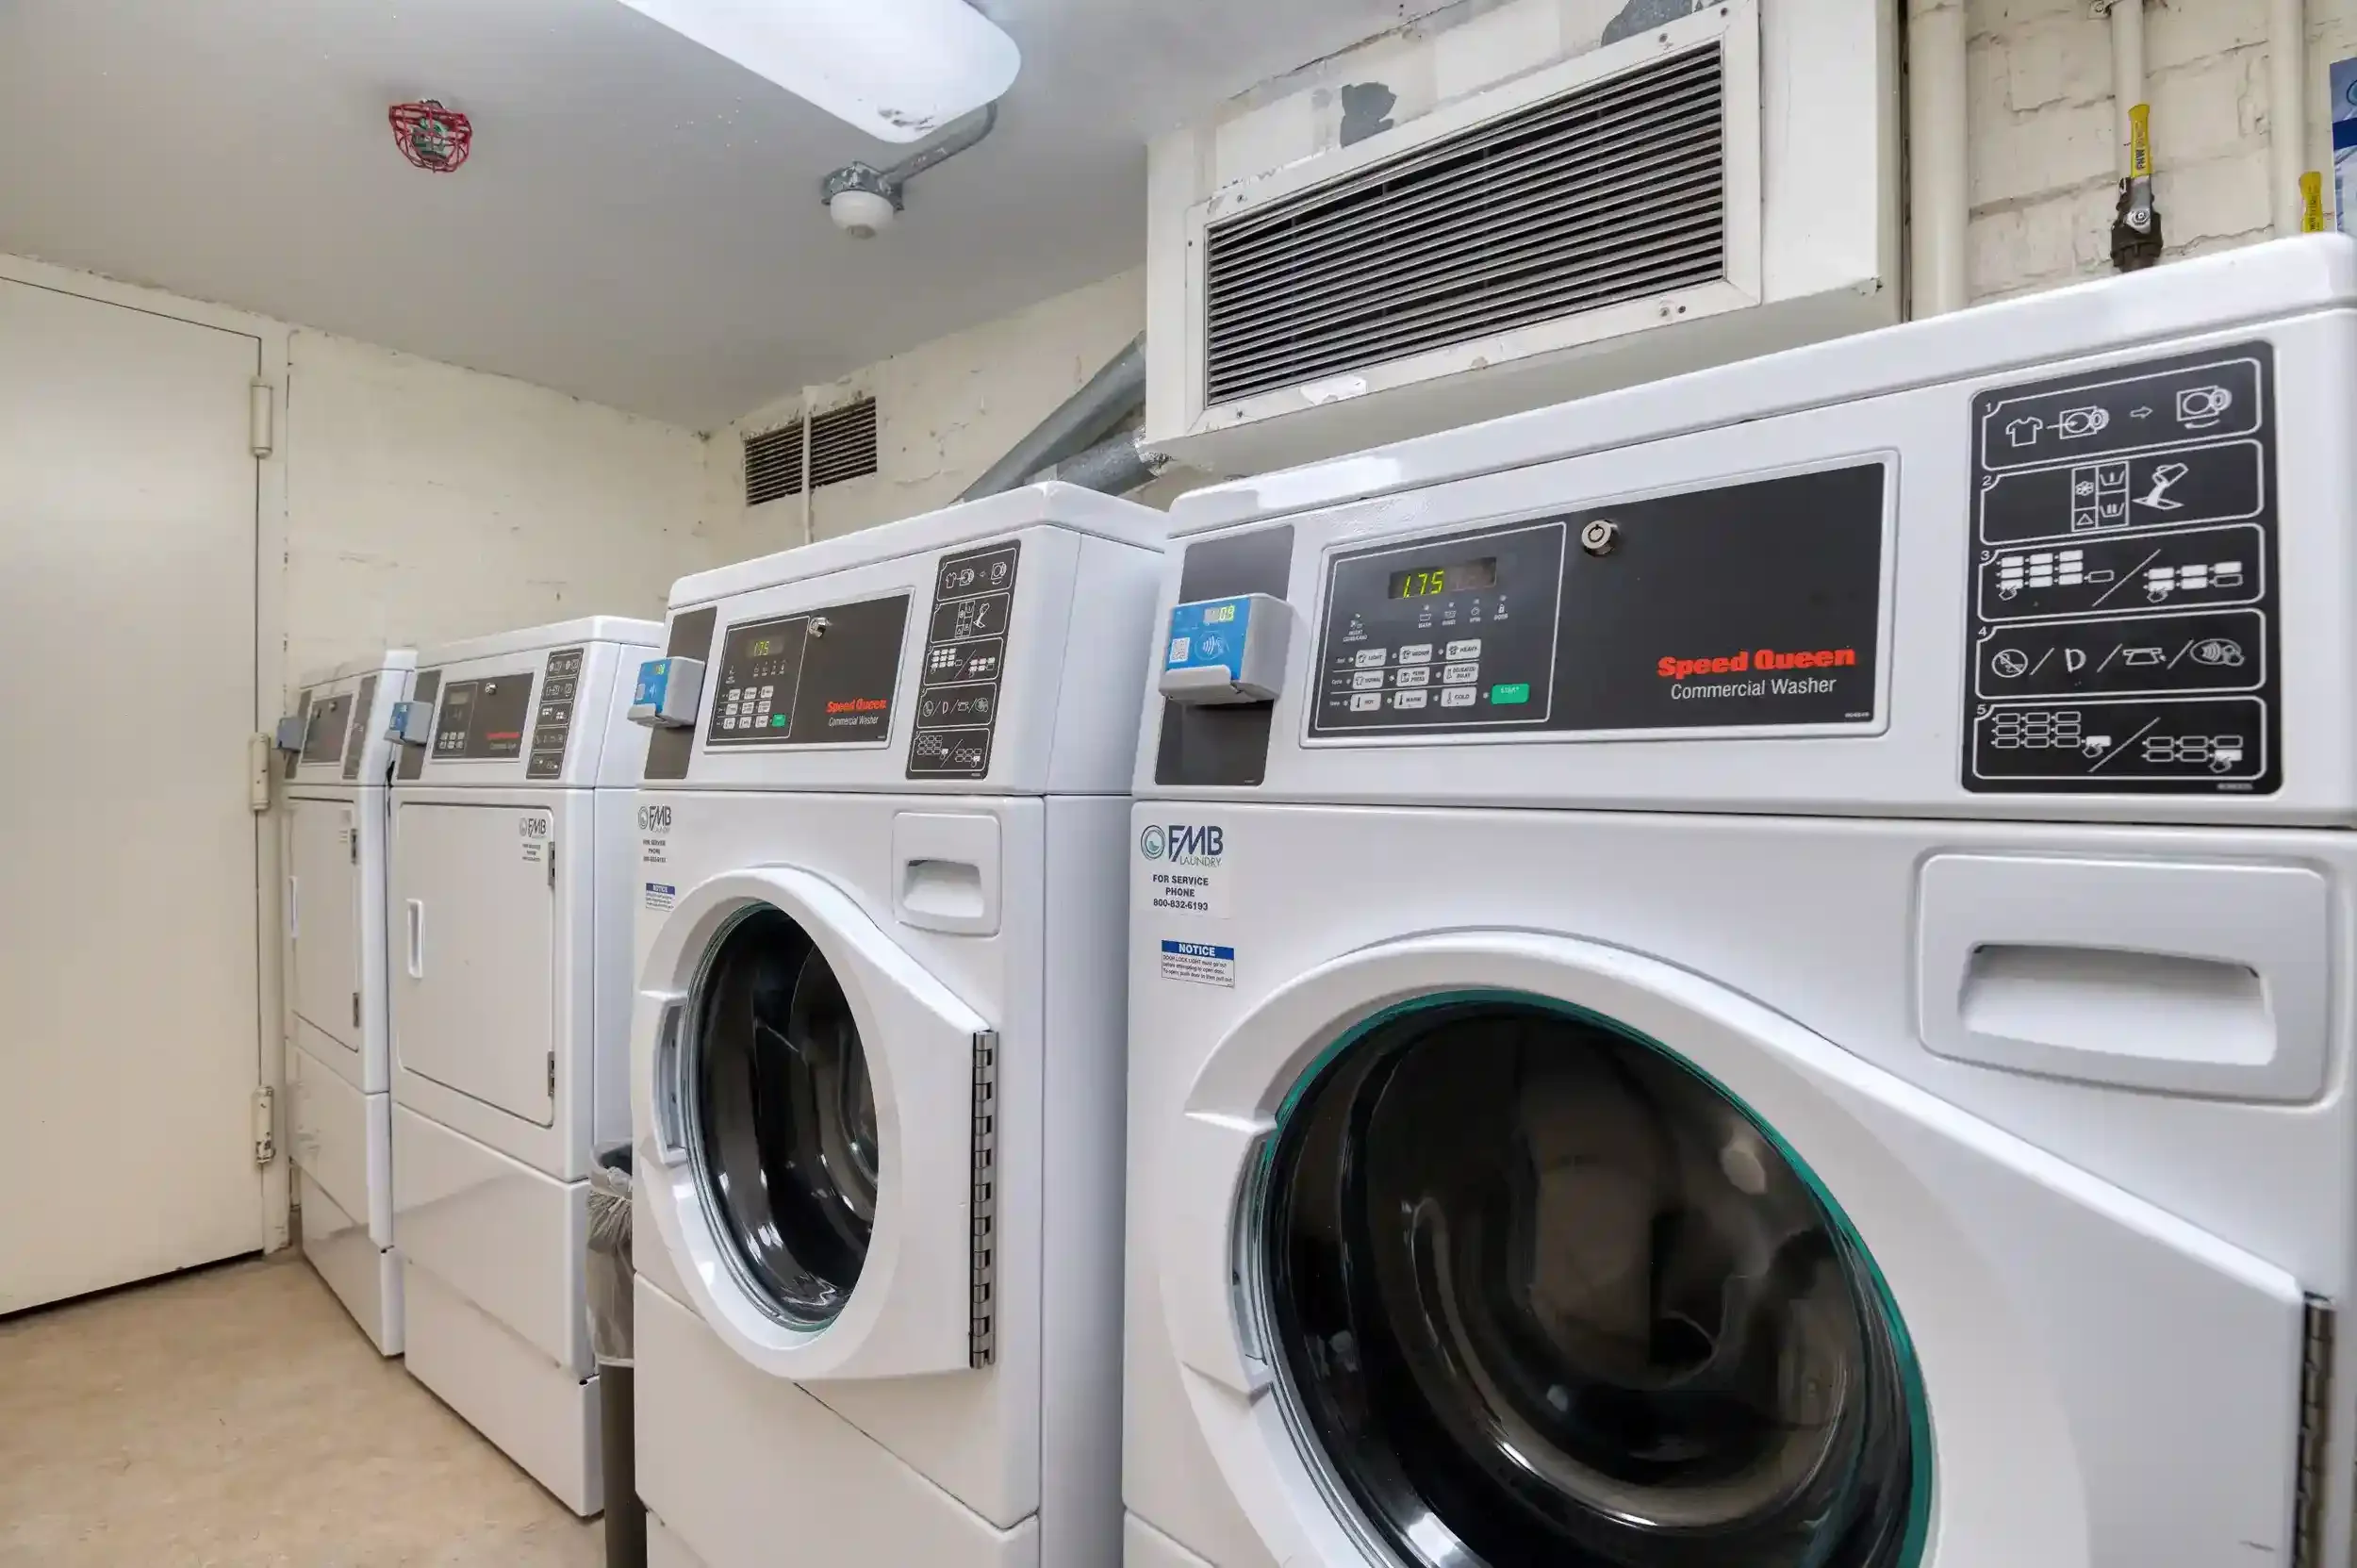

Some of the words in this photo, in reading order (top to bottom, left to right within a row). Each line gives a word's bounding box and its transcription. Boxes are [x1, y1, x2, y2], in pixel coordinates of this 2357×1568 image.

[1984, 403, 1991, 412] 1
[1982, 475, 1991, 486] 2
[1980, 550, 1990, 561] 3
[1403, 569, 1444, 599] 1.75
[1978, 626, 1987, 636] 4
[1657, 649, 1750, 679] Speed
[1755, 648, 1855, 669] Queen
[1671, 680, 1765, 700] Commercial
[1771, 677, 1837, 695] Washer
[827, 700, 856, 714] Speed
[856, 699, 887, 710] Queen
[1977, 704, 1986, 715] 5
[829, 717, 858, 727] Commercial
[859, 716, 879, 725] Washer
[650, 805, 671, 831] FMB
[528, 818, 546, 837] FMB
[1169, 825, 1224, 862] FMB
[1180, 855, 1222, 867] LAUNDRY
[1153, 874, 1169, 883] FOR
[1172, 876, 1209, 885] SERVICE
[1165, 887, 1195, 897] PHONE
[1153, 899, 1208, 910] 800-832-6193
[1178, 944, 1215, 956] NOTICE
